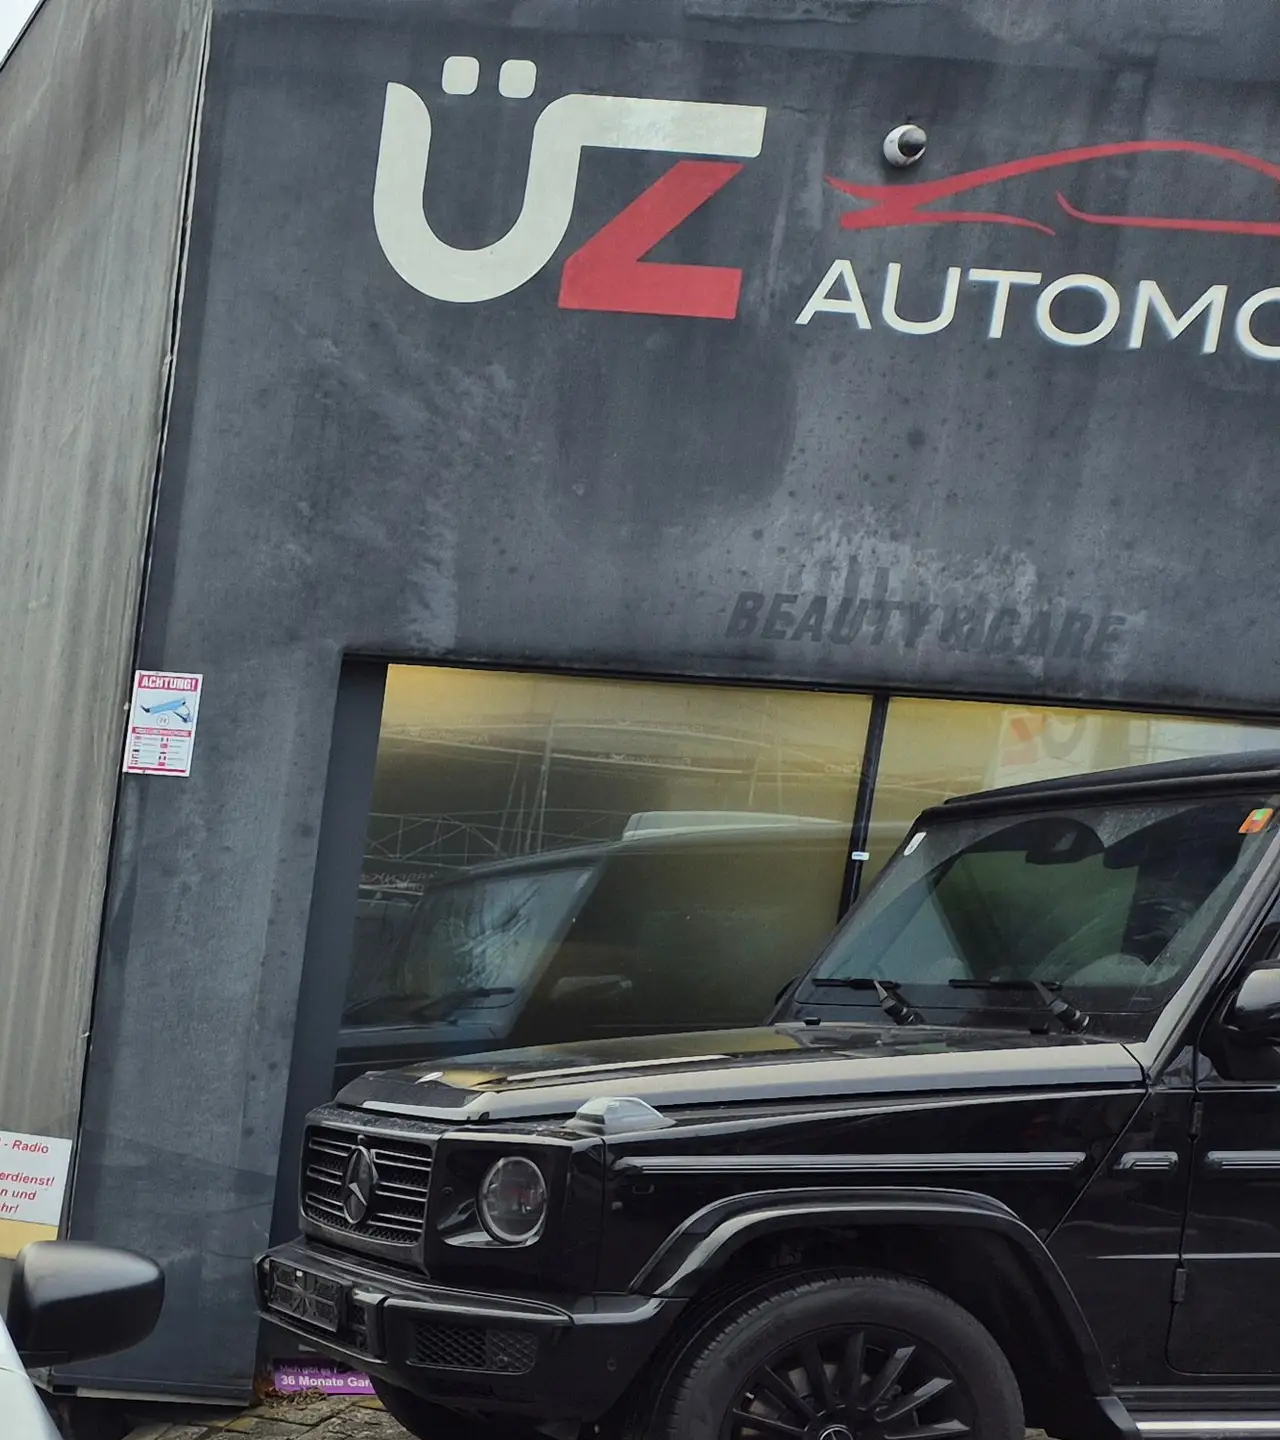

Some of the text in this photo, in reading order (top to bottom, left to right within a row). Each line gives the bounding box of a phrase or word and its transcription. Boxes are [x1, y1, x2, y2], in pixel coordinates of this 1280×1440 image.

[373, 56, 766, 319] ÜZ
[140, 676, 197, 691] ACHTUNG!
[12, 1139, 49, 1154] Radio
[12, 1190, 37, 1201] und
[281, 1375, 372, 1387] 36 Monate Gar
